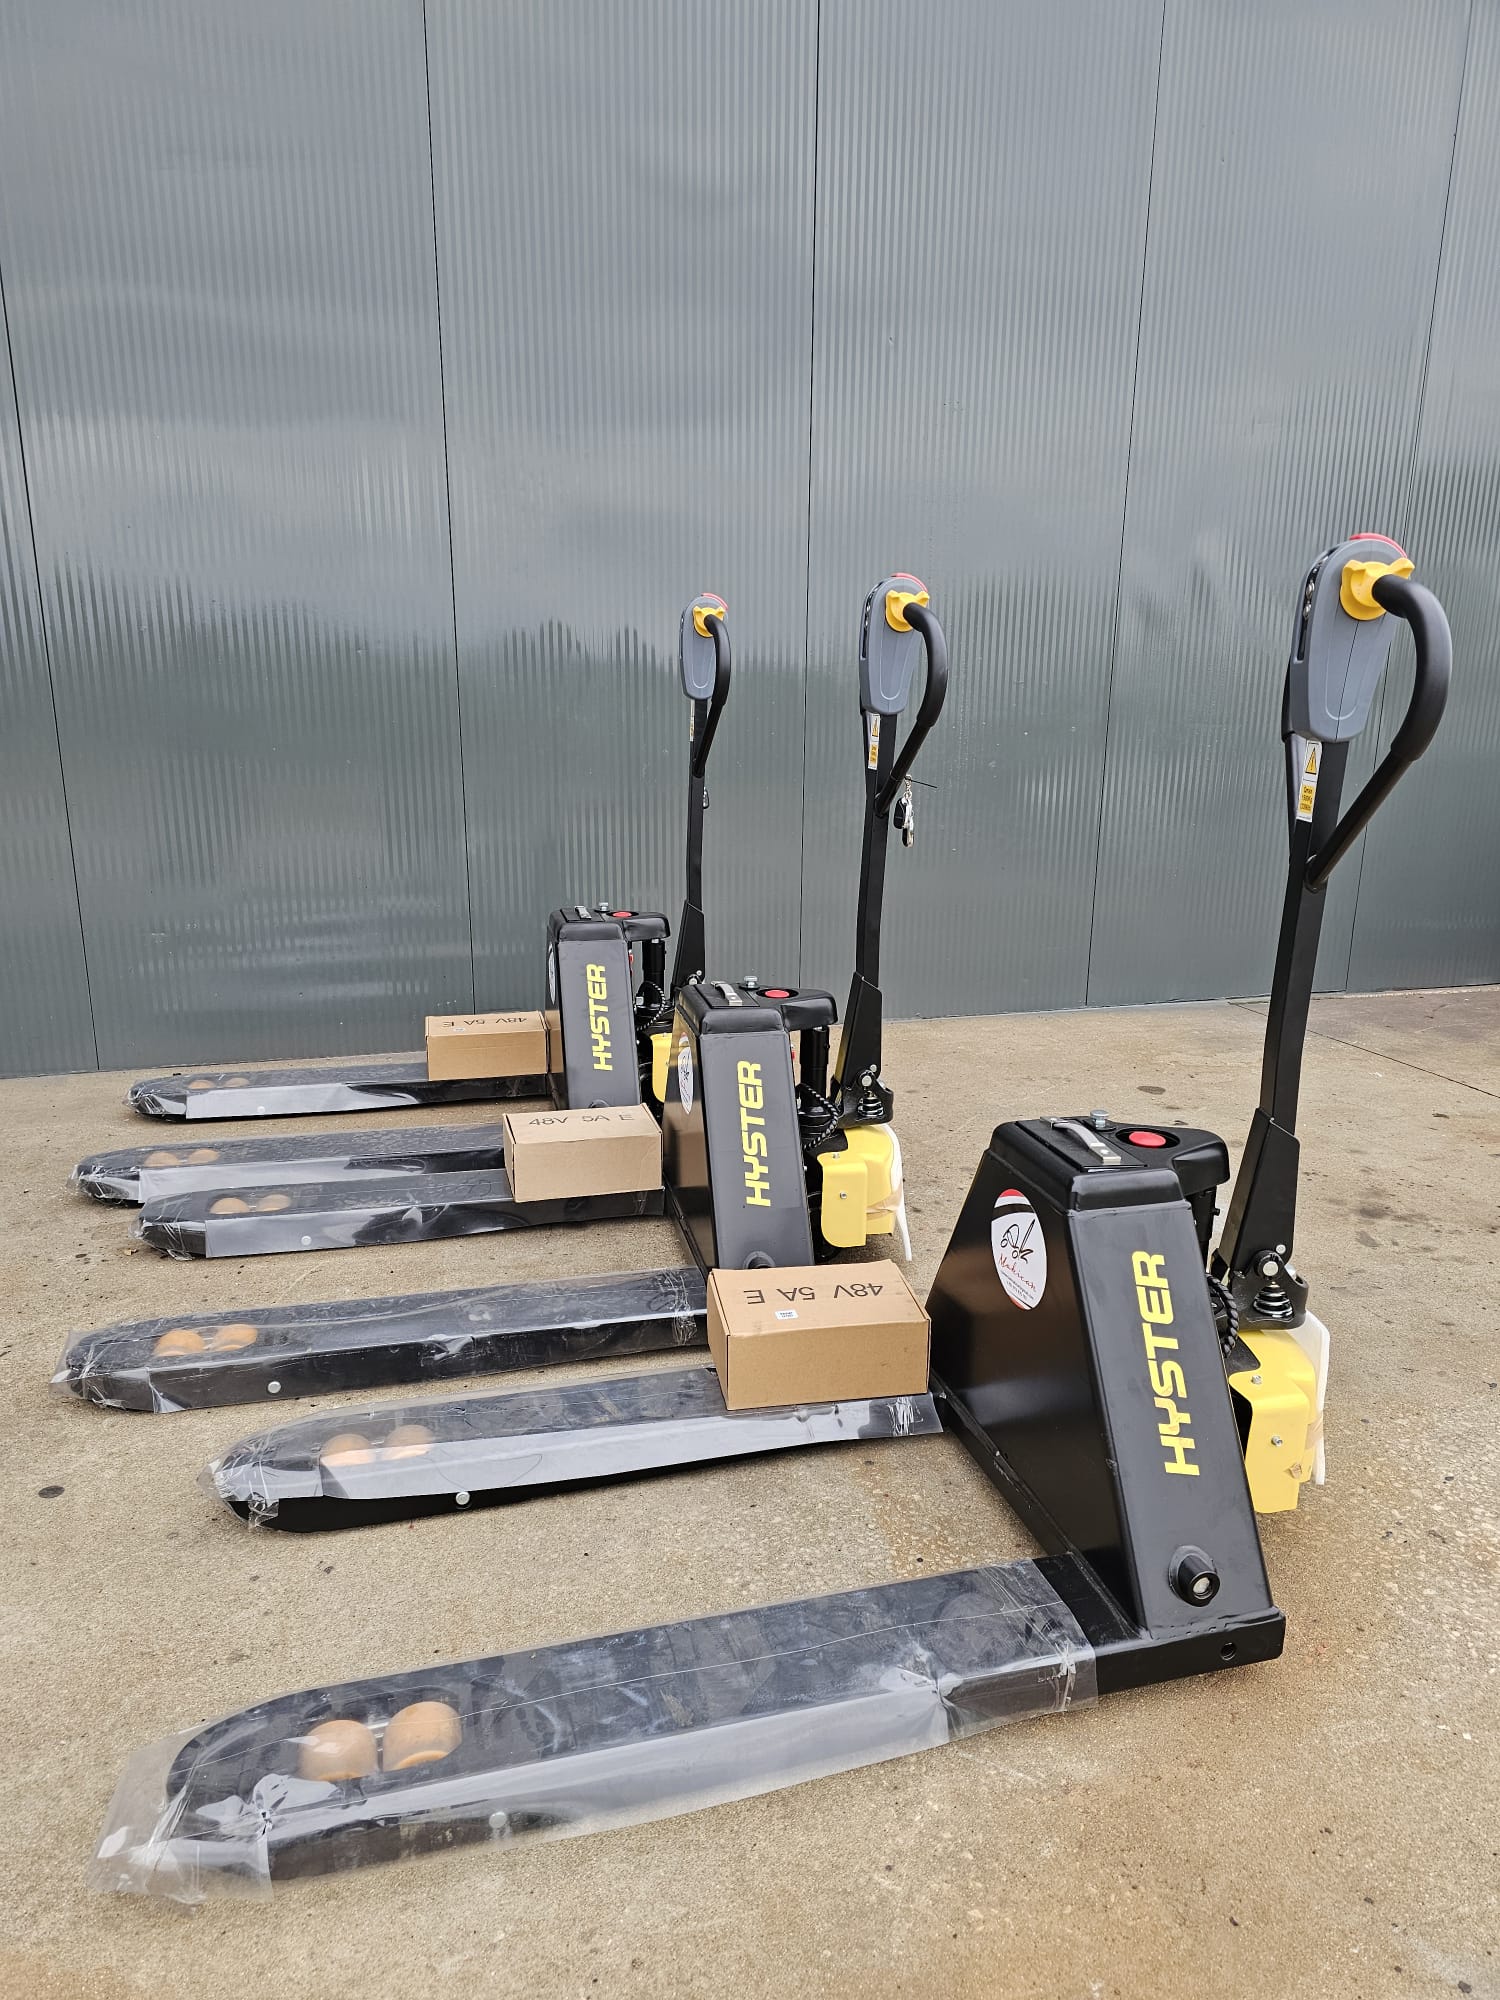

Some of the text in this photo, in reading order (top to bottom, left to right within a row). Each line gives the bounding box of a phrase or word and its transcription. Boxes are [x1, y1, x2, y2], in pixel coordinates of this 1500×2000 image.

[586, 963, 613, 1071] HYSTER
[528, 1113, 636, 1126] 48V 5A E
[736, 1060, 771, 1208] HYSTER
[743, 1282, 884, 1305] 48V 5A E
[1132, 1250, 1200, 1477] HYSTER
